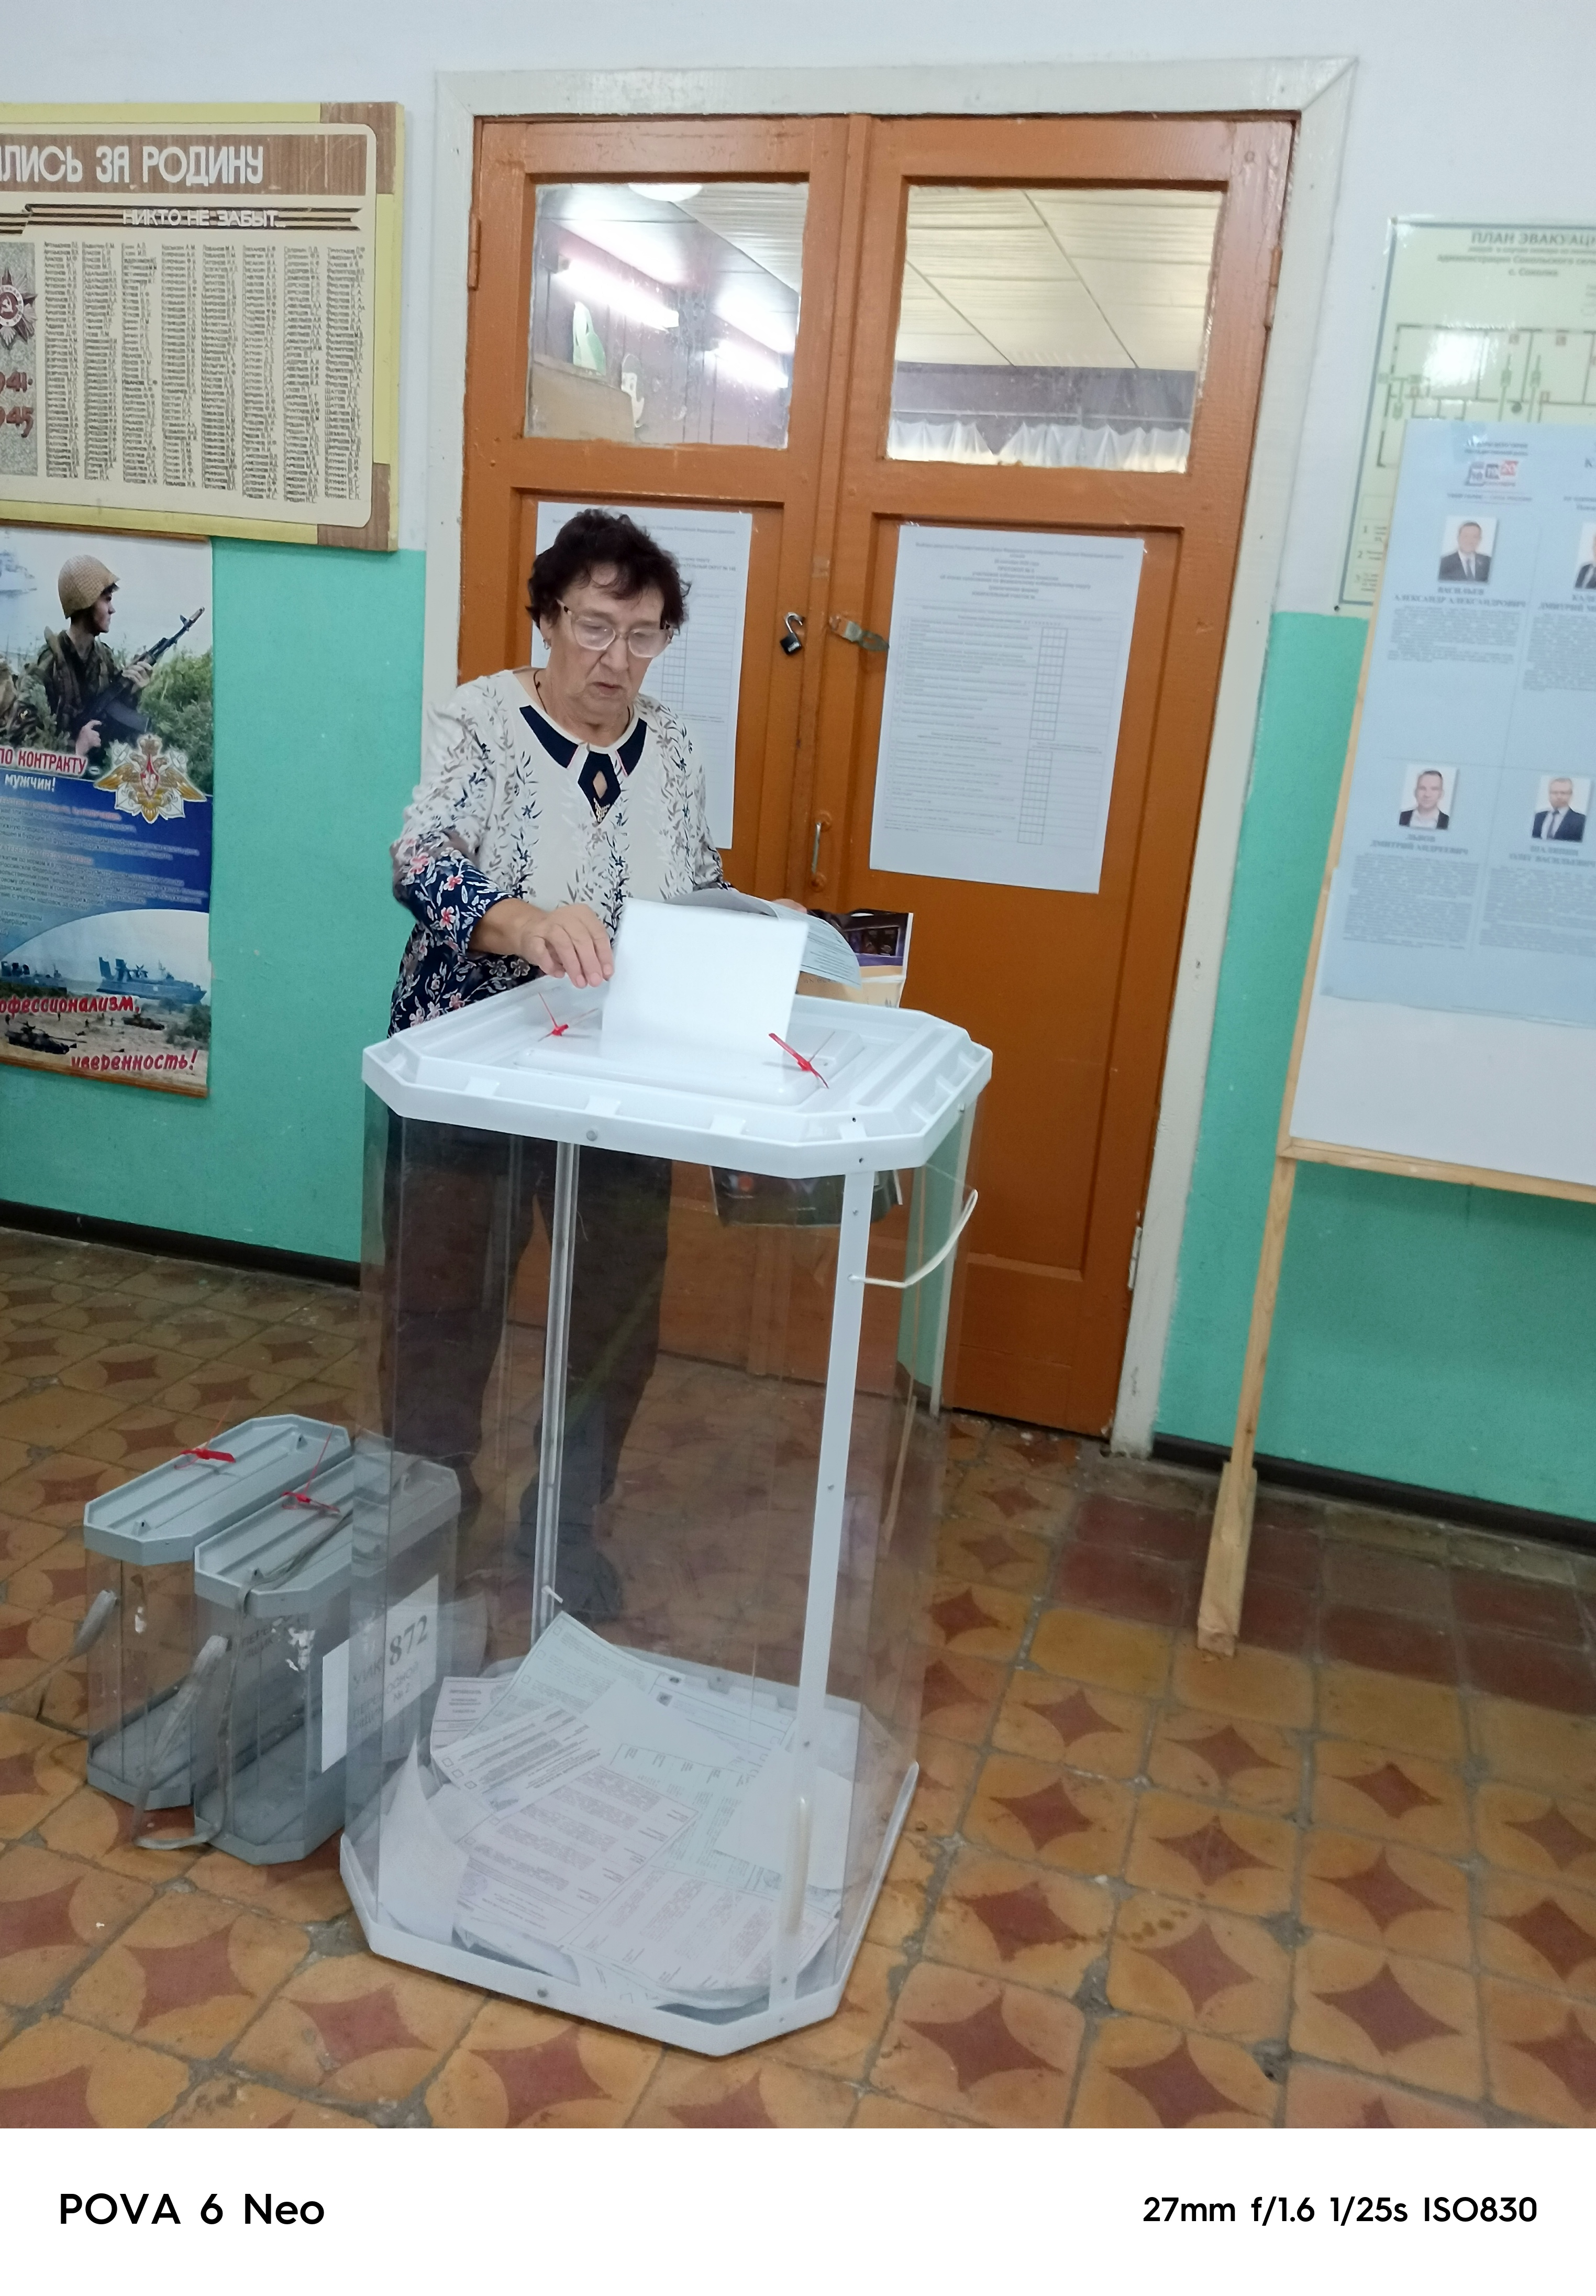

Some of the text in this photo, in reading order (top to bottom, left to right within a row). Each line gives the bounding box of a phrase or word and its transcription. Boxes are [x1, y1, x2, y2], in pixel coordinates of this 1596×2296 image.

[0, 145, 263, 186] ЛИСЬ ЗА РОДИНУ
[123, 209, 181, 226] НИКТО
[188, 209, 209, 226] НЕ
[1471, 232, 1515, 245] ПЛАН
[18, 750, 86, 774] КОНТРАКТУ
[5, 774, 56, 792] мужчин!
[71, 1049, 198, 1072] уверенность!
[390, 1614, 428, 1666] 872
